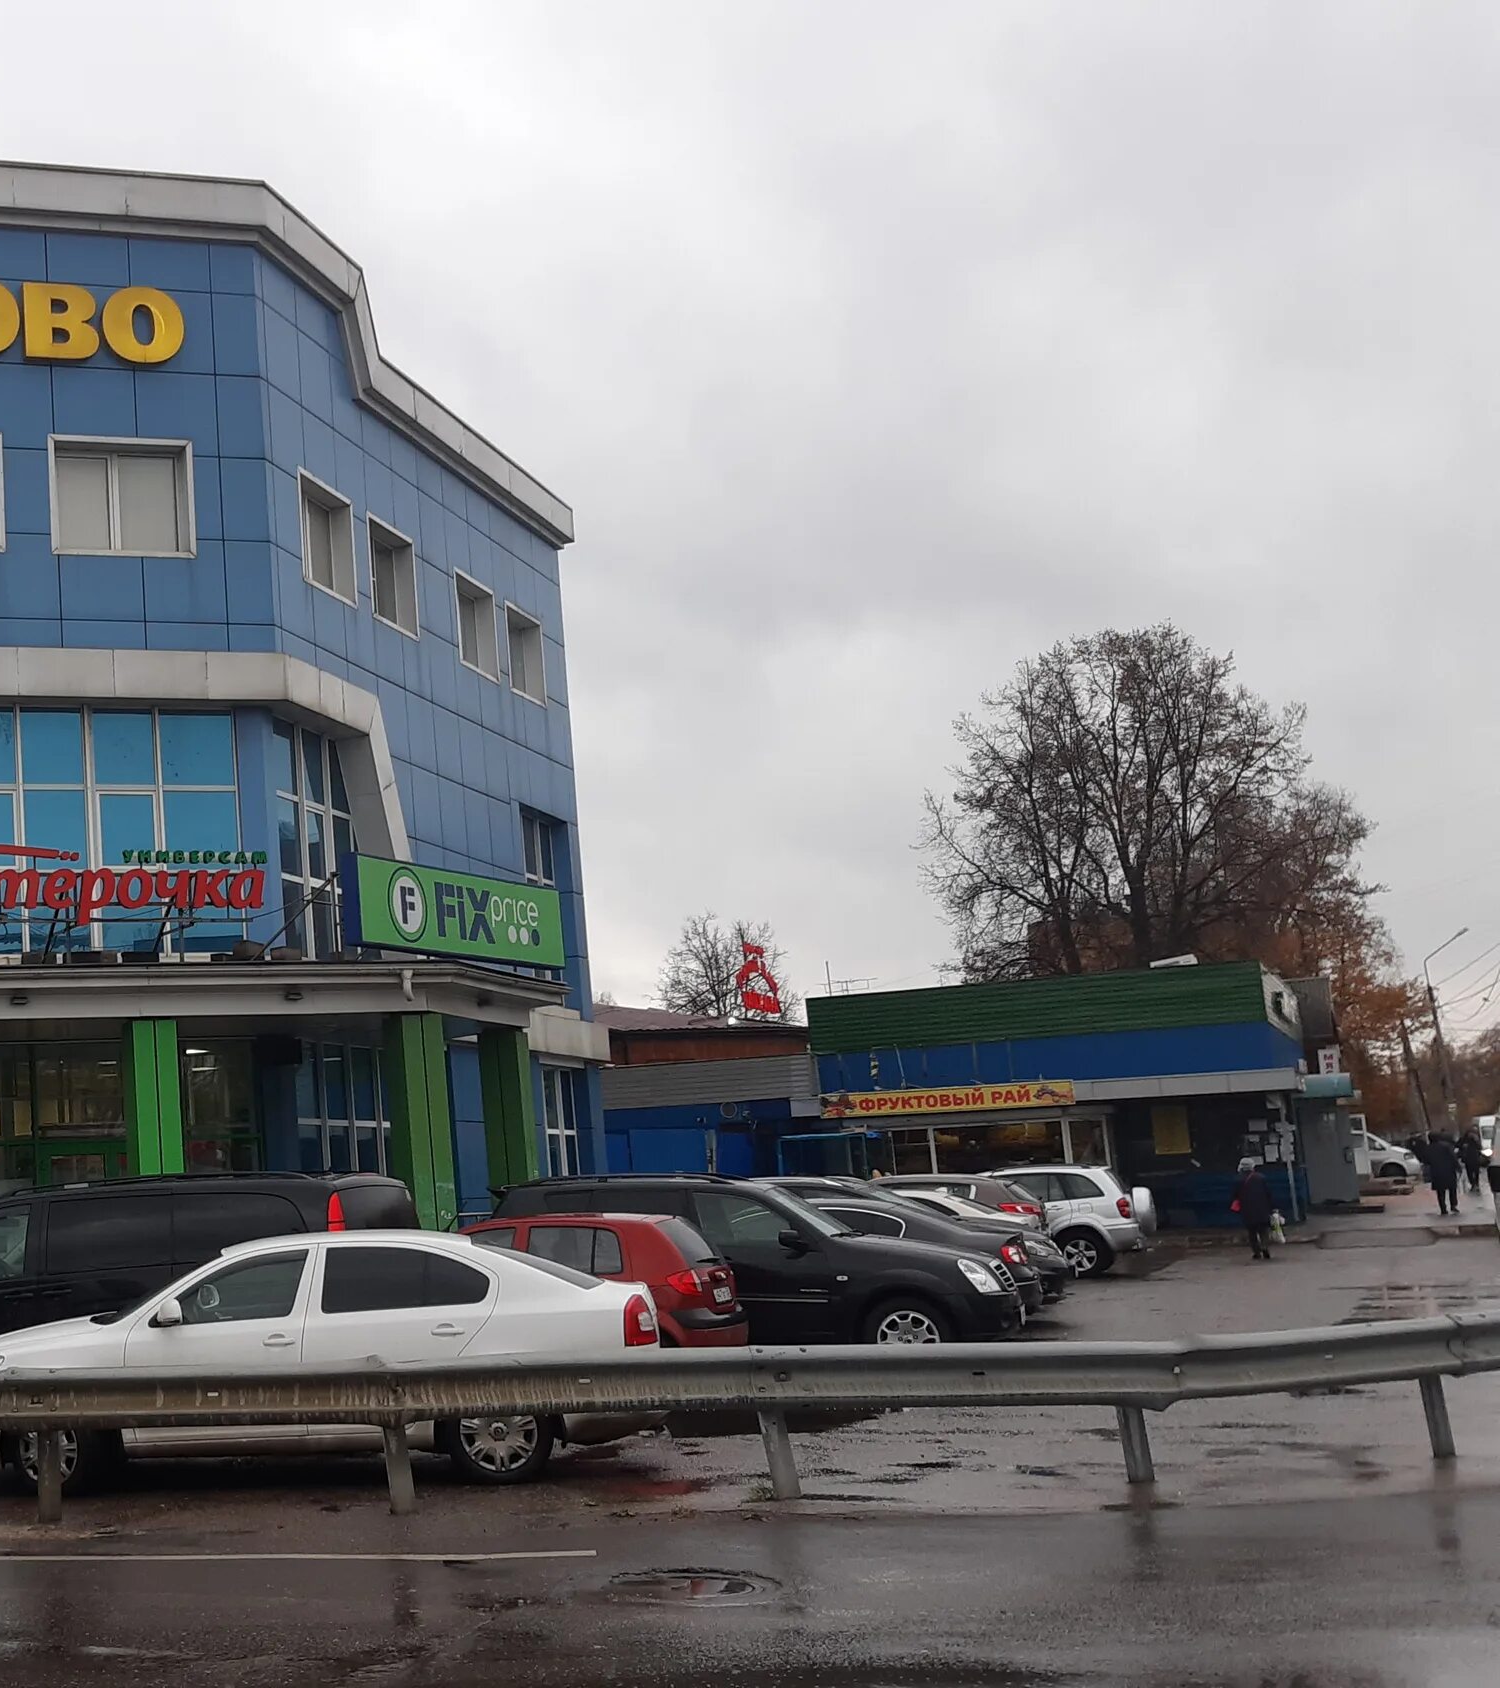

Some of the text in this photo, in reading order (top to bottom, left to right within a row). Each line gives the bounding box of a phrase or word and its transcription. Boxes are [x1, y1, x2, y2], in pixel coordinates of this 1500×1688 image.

[122, 849, 268, 865] УНИВЕРСАМ
[858, 1084, 1030, 1112] ФРУКТОВЫЙ РАЙ
